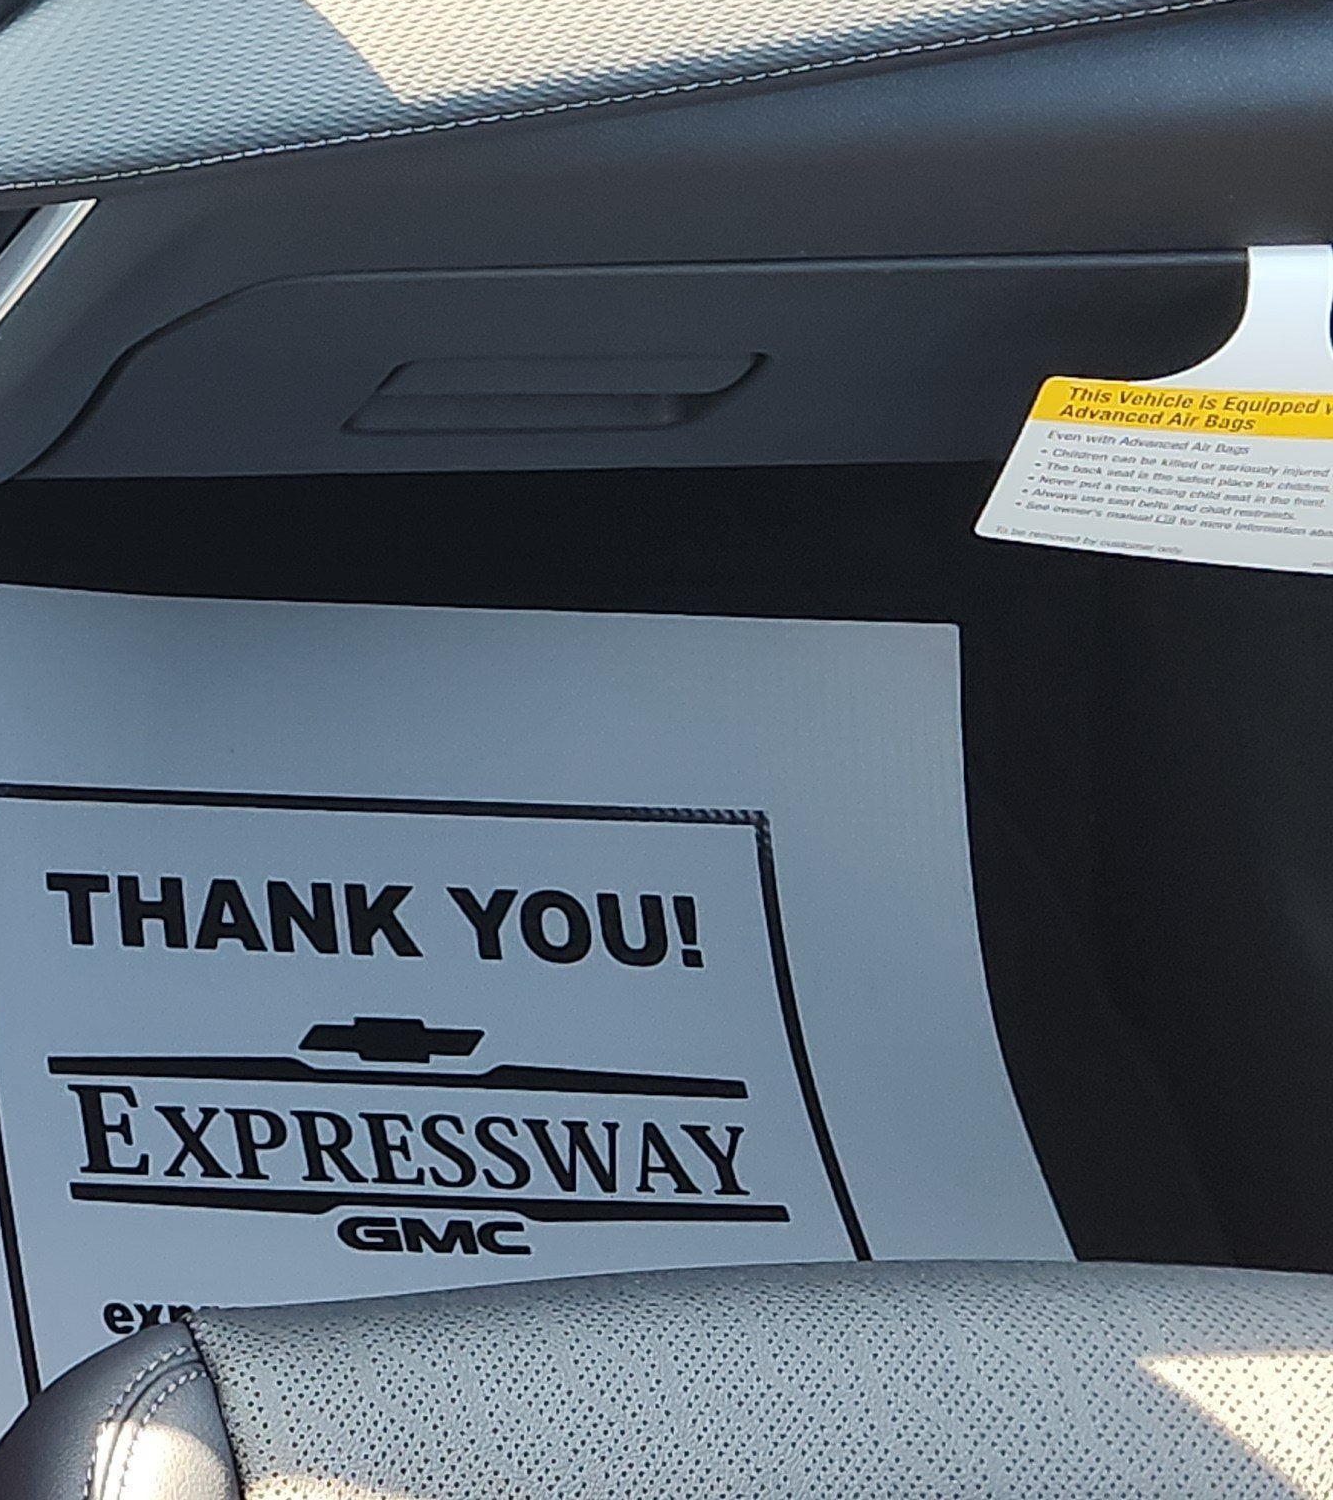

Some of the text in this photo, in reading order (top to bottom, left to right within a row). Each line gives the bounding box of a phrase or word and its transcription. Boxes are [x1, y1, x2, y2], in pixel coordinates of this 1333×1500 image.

[1059, 404, 1256, 433] Advanced Air Bags
[1070, 387, 1113, 404] This
[1119, 390, 1193, 410] Vehicle
[1199, 395, 1218, 411] is
[1222, 396, 1320, 416] Equipped
[45, 871, 705, 969] THANK YOU!
[336, 1215, 532, 1256] GMC
